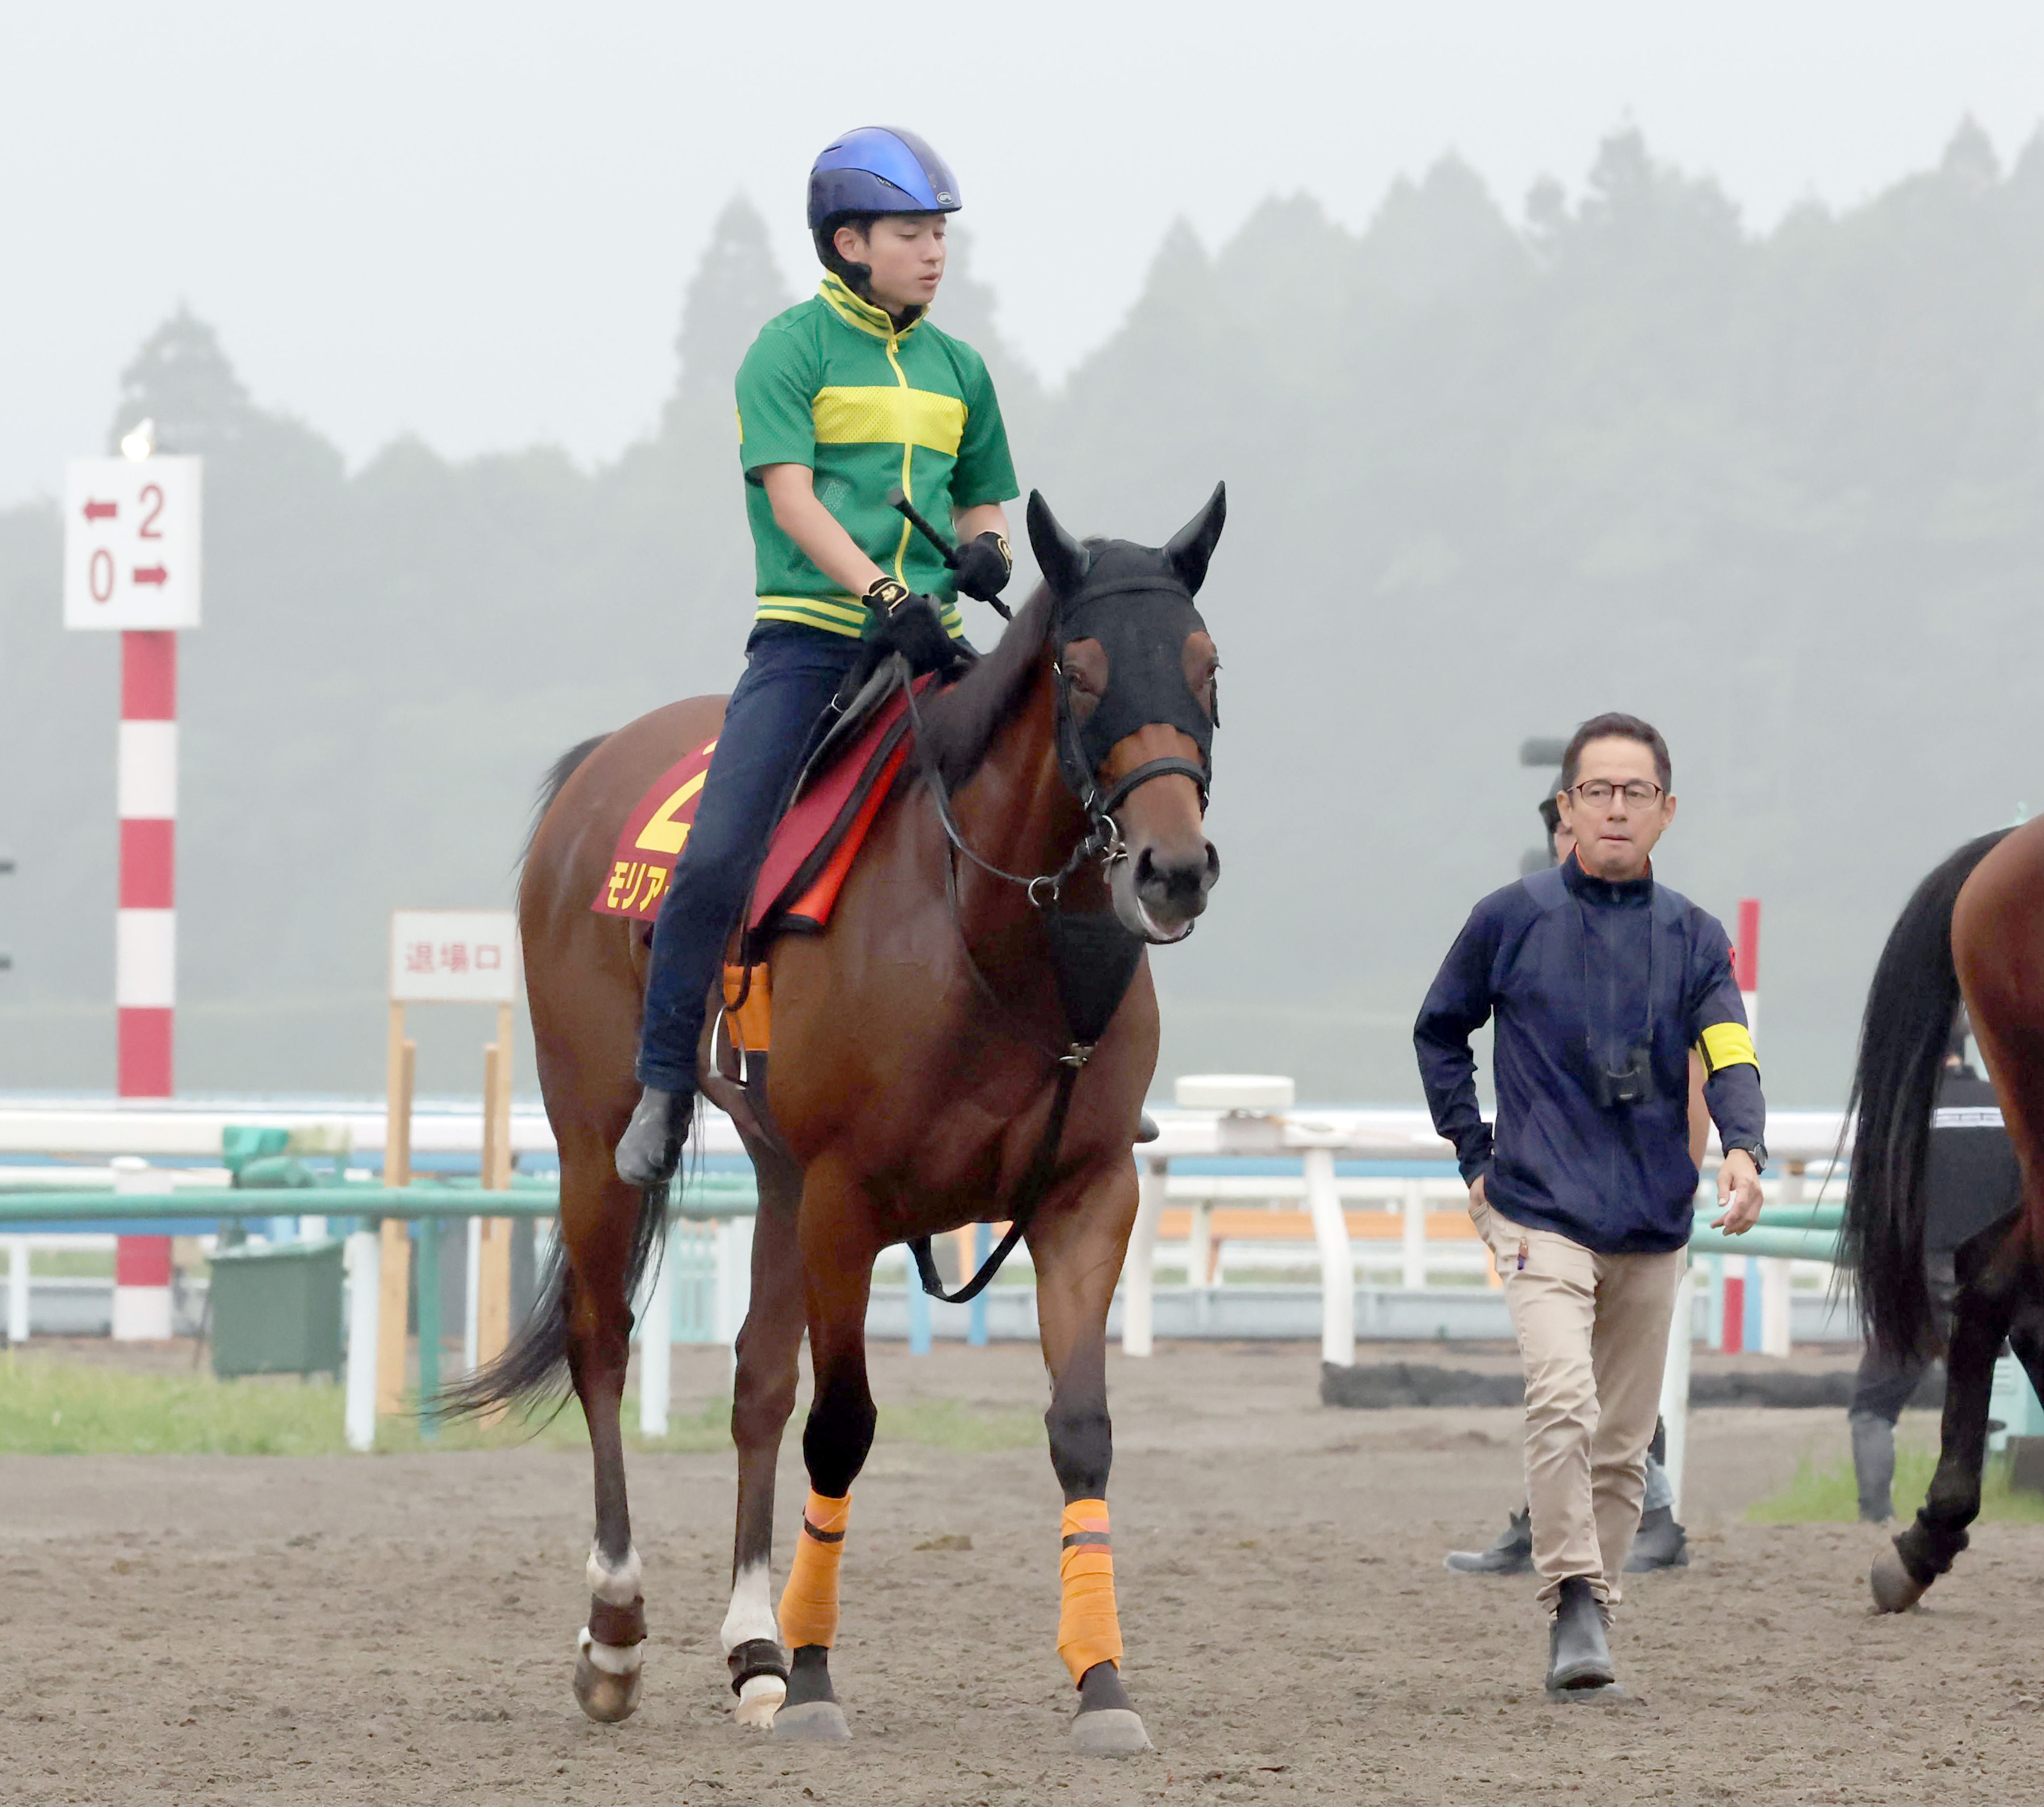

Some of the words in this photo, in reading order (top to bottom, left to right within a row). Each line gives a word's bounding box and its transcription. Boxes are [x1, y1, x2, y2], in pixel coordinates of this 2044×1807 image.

[139, 484, 163, 538] 2
[90, 548, 114, 603] 0
[607, 861, 670, 912] モリア
[406, 942, 502, 973] 退場口
